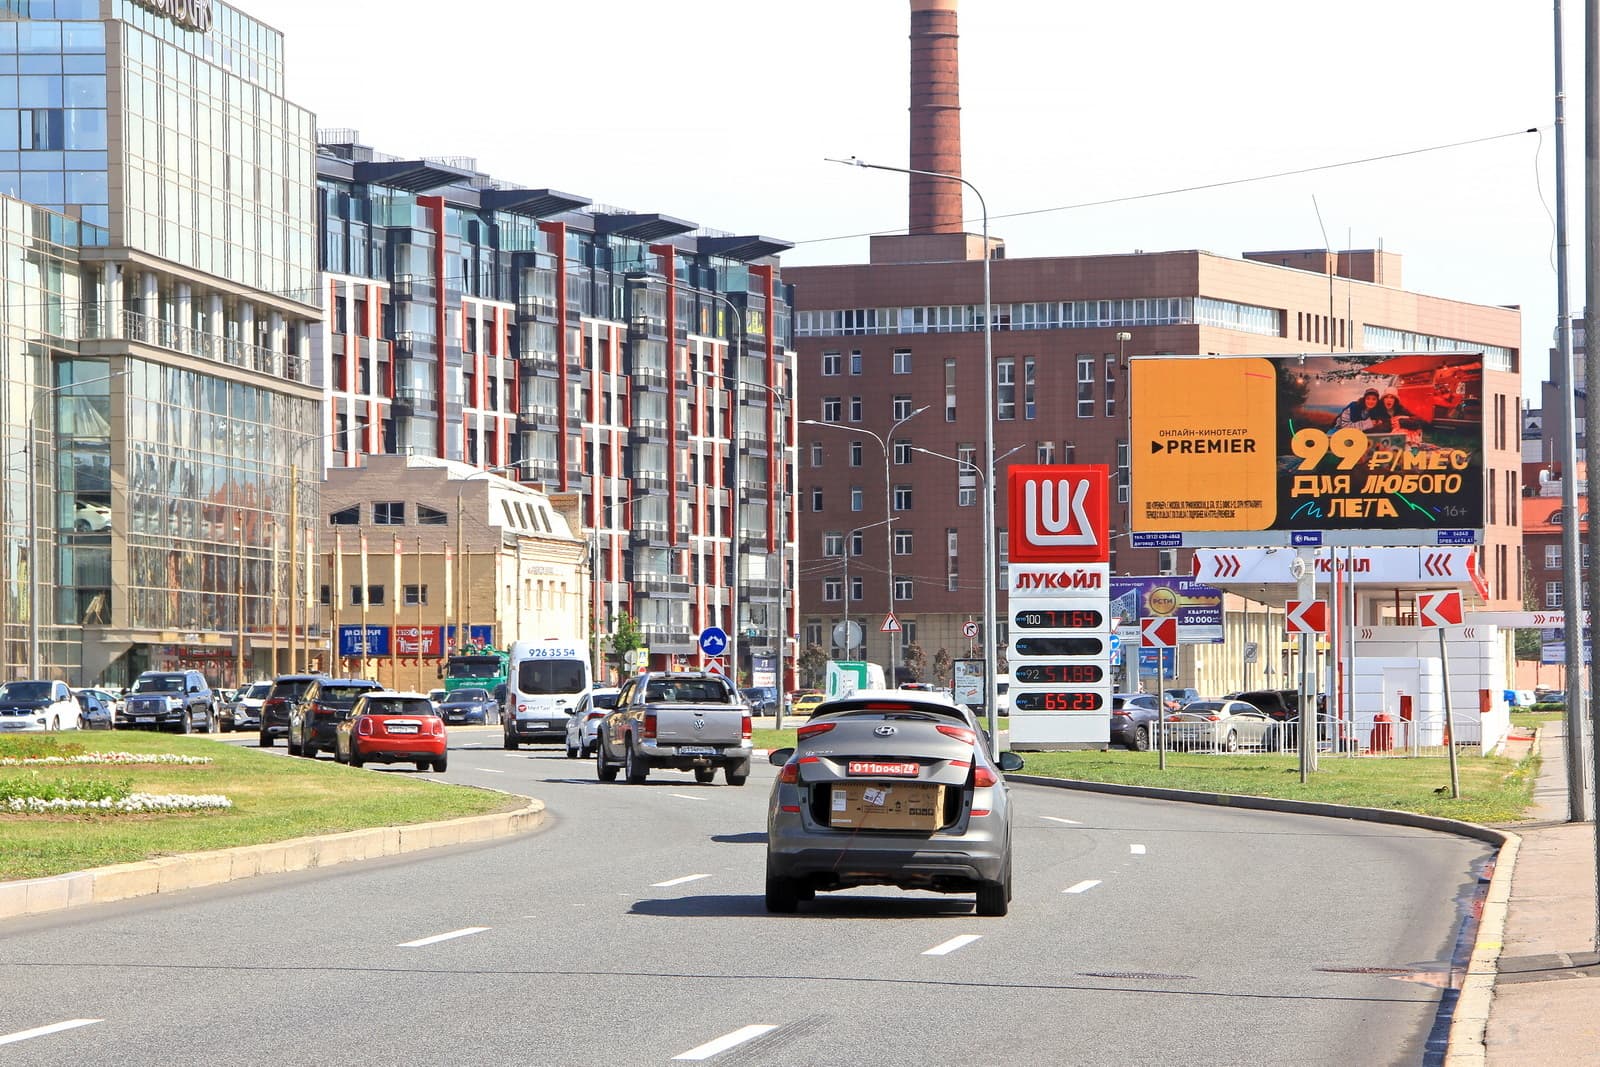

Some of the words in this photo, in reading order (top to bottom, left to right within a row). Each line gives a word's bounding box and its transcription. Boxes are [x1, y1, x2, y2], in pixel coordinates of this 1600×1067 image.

[1159, 428, 1248, 437] ОНЛАЙН-КИНОТЕАТР
[1167, 439, 1256, 454] PREMIER
[1291, 428, 1369, 471] 99
[1290, 475, 1350, 498] ДЛЯ
[1360, 474, 1462, 494] ЛЮБОГО
[1327, 498, 1399, 518] ЛЕТА
[1443, 505, 1468, 517] 16+
[1016, 569, 1102, 588] ЛУКОЙЛ
[1026, 615, 1041, 625] 100
[528, 648, 547, 657] 926
[549, 648, 561, 657] 35
[564, 648, 575, 657] 54
[1026, 669, 1039, 680] 92
